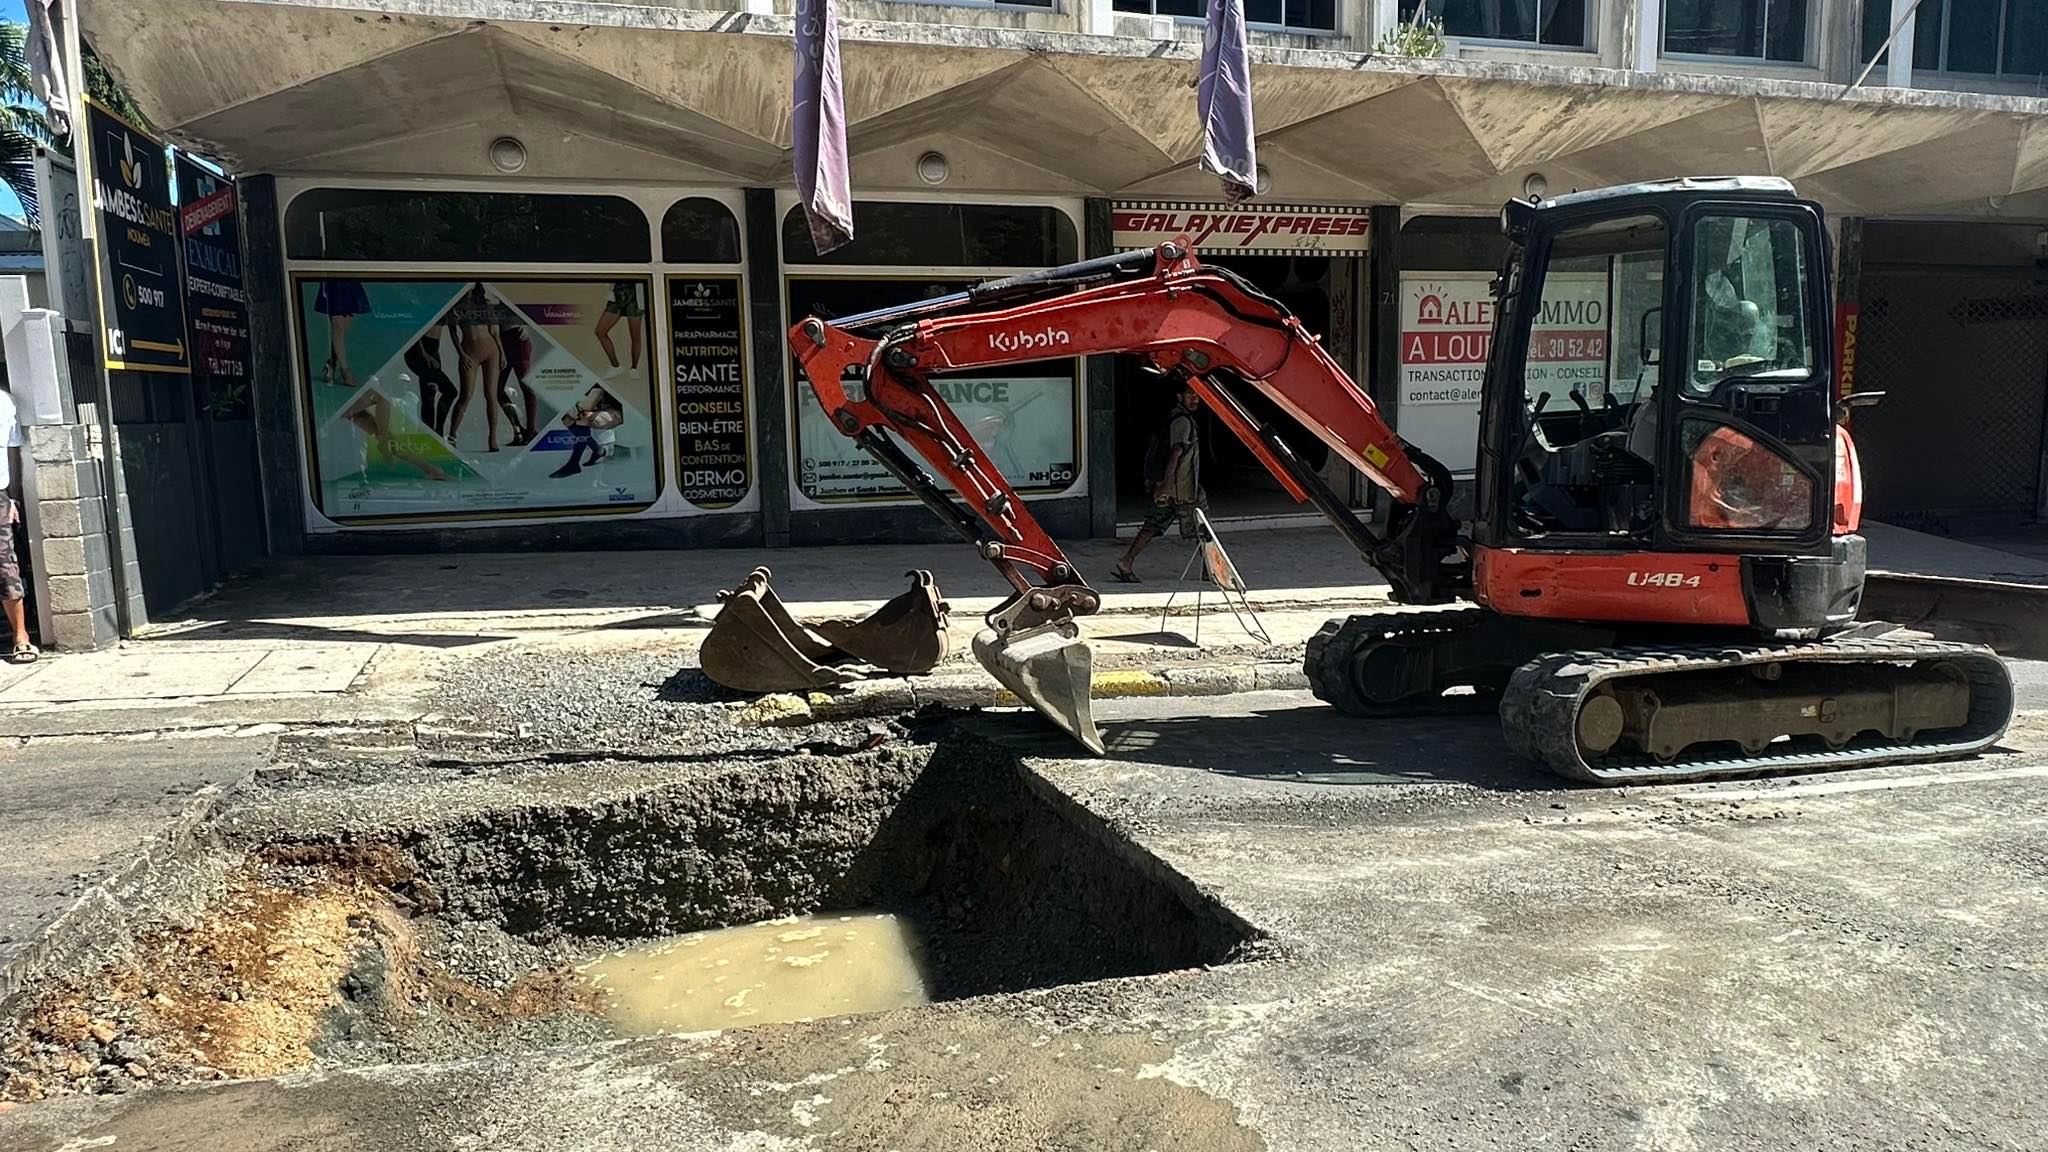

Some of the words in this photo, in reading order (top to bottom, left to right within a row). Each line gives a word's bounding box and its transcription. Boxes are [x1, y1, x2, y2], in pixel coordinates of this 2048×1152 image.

[138, 285, 152, 305] 500
[1383, 291, 1395, 304] 71
[1444, 301, 1494, 325] ALE
[1534, 300, 1602, 325] MMO
[107, 328, 126, 356] ICI
[988, 326, 1070, 352] Kubota
[676, 345, 738, 357] NUTRITION
[1408, 335, 1426, 360] A
[1549, 338, 1565, 358] 30
[1568, 337, 1583, 358] 52
[1587, 338, 1602, 358] 42
[676, 359, 740, 382] SANTÉ
[1557, 367, 1604, 379] CONSEIL
[677, 384, 742, 395] PERFORMANCE
[679, 401, 742, 414] CONSEILS
[680, 418, 744, 435] BIEN-ÊTRE
[694, 439, 719, 452] BAS
[681, 454, 746, 465] CONTENTION
[684, 469, 746, 486] DERMO
[1627, 572, 1701, 587] U48-4
